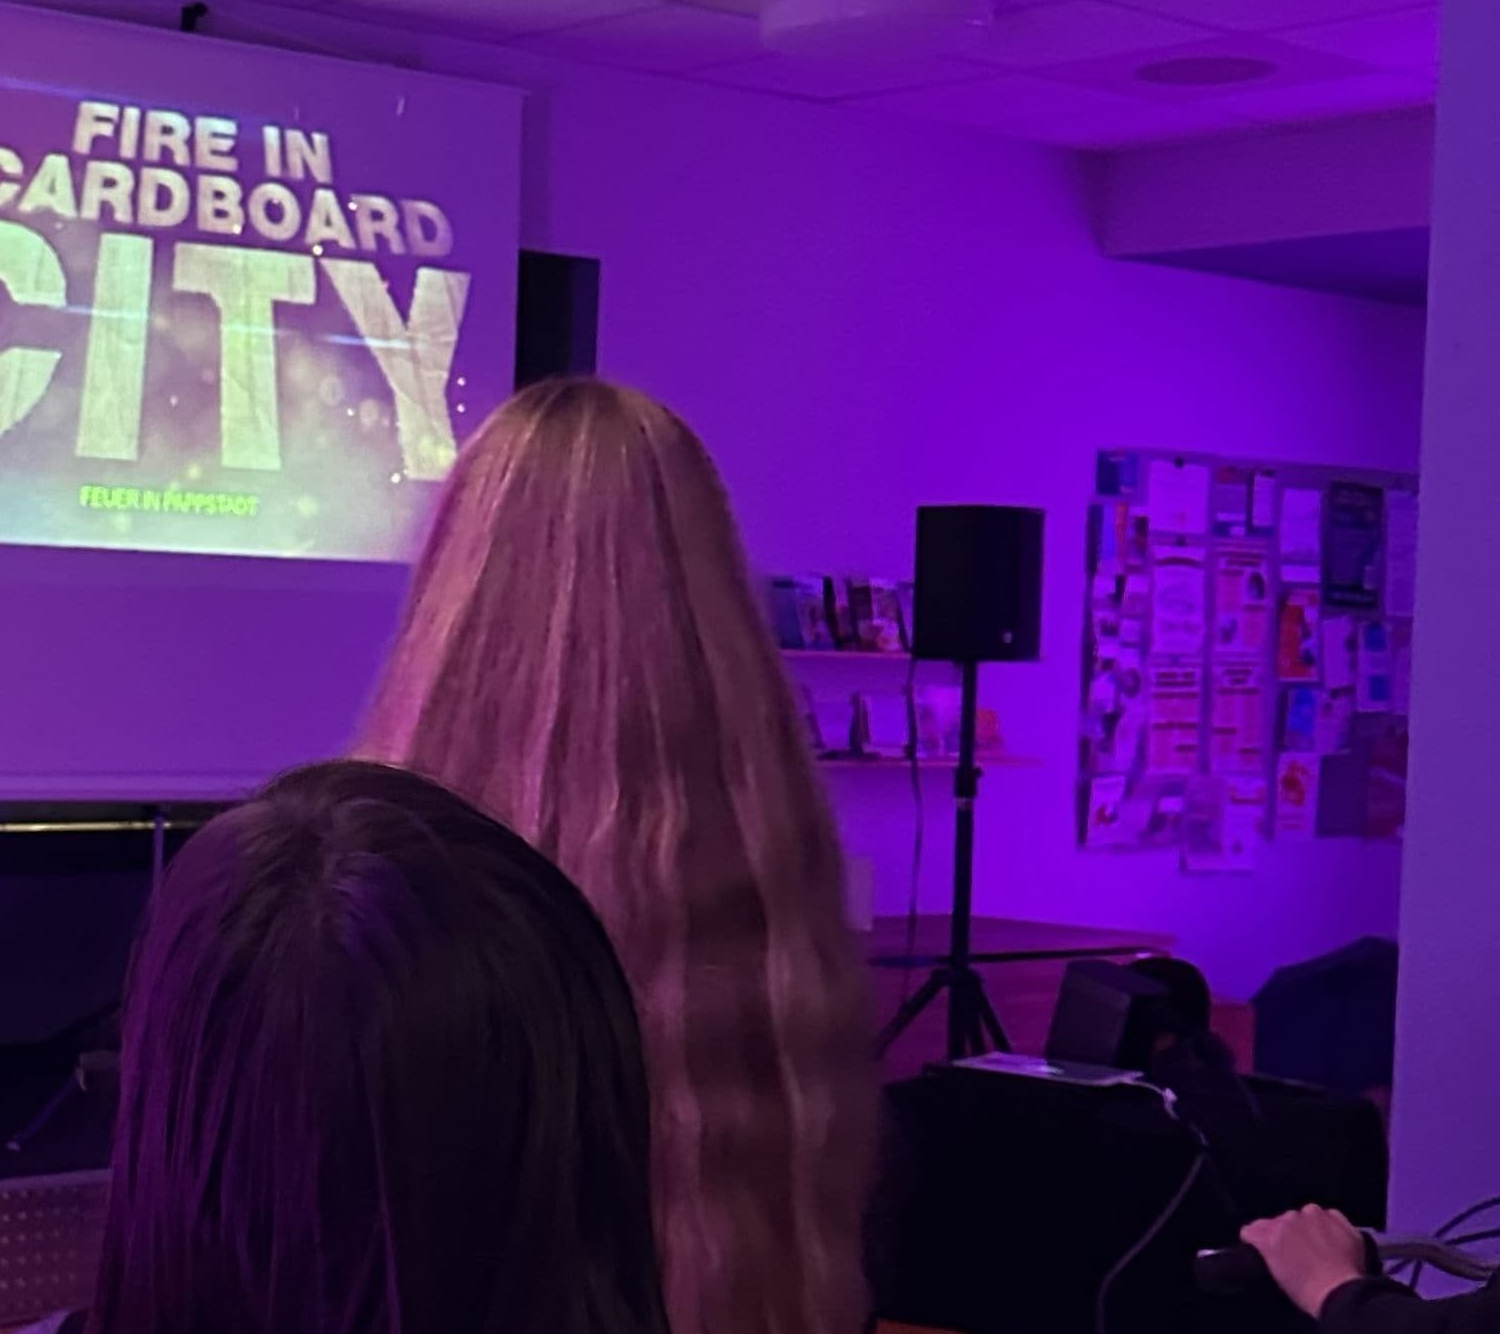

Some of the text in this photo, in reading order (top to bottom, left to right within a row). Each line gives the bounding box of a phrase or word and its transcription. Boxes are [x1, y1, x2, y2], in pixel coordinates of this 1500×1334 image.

[73, 101, 333, 182] FIRE IN
[80, 485, 139, 509] FEUER
[143, 490, 161, 512] IN
